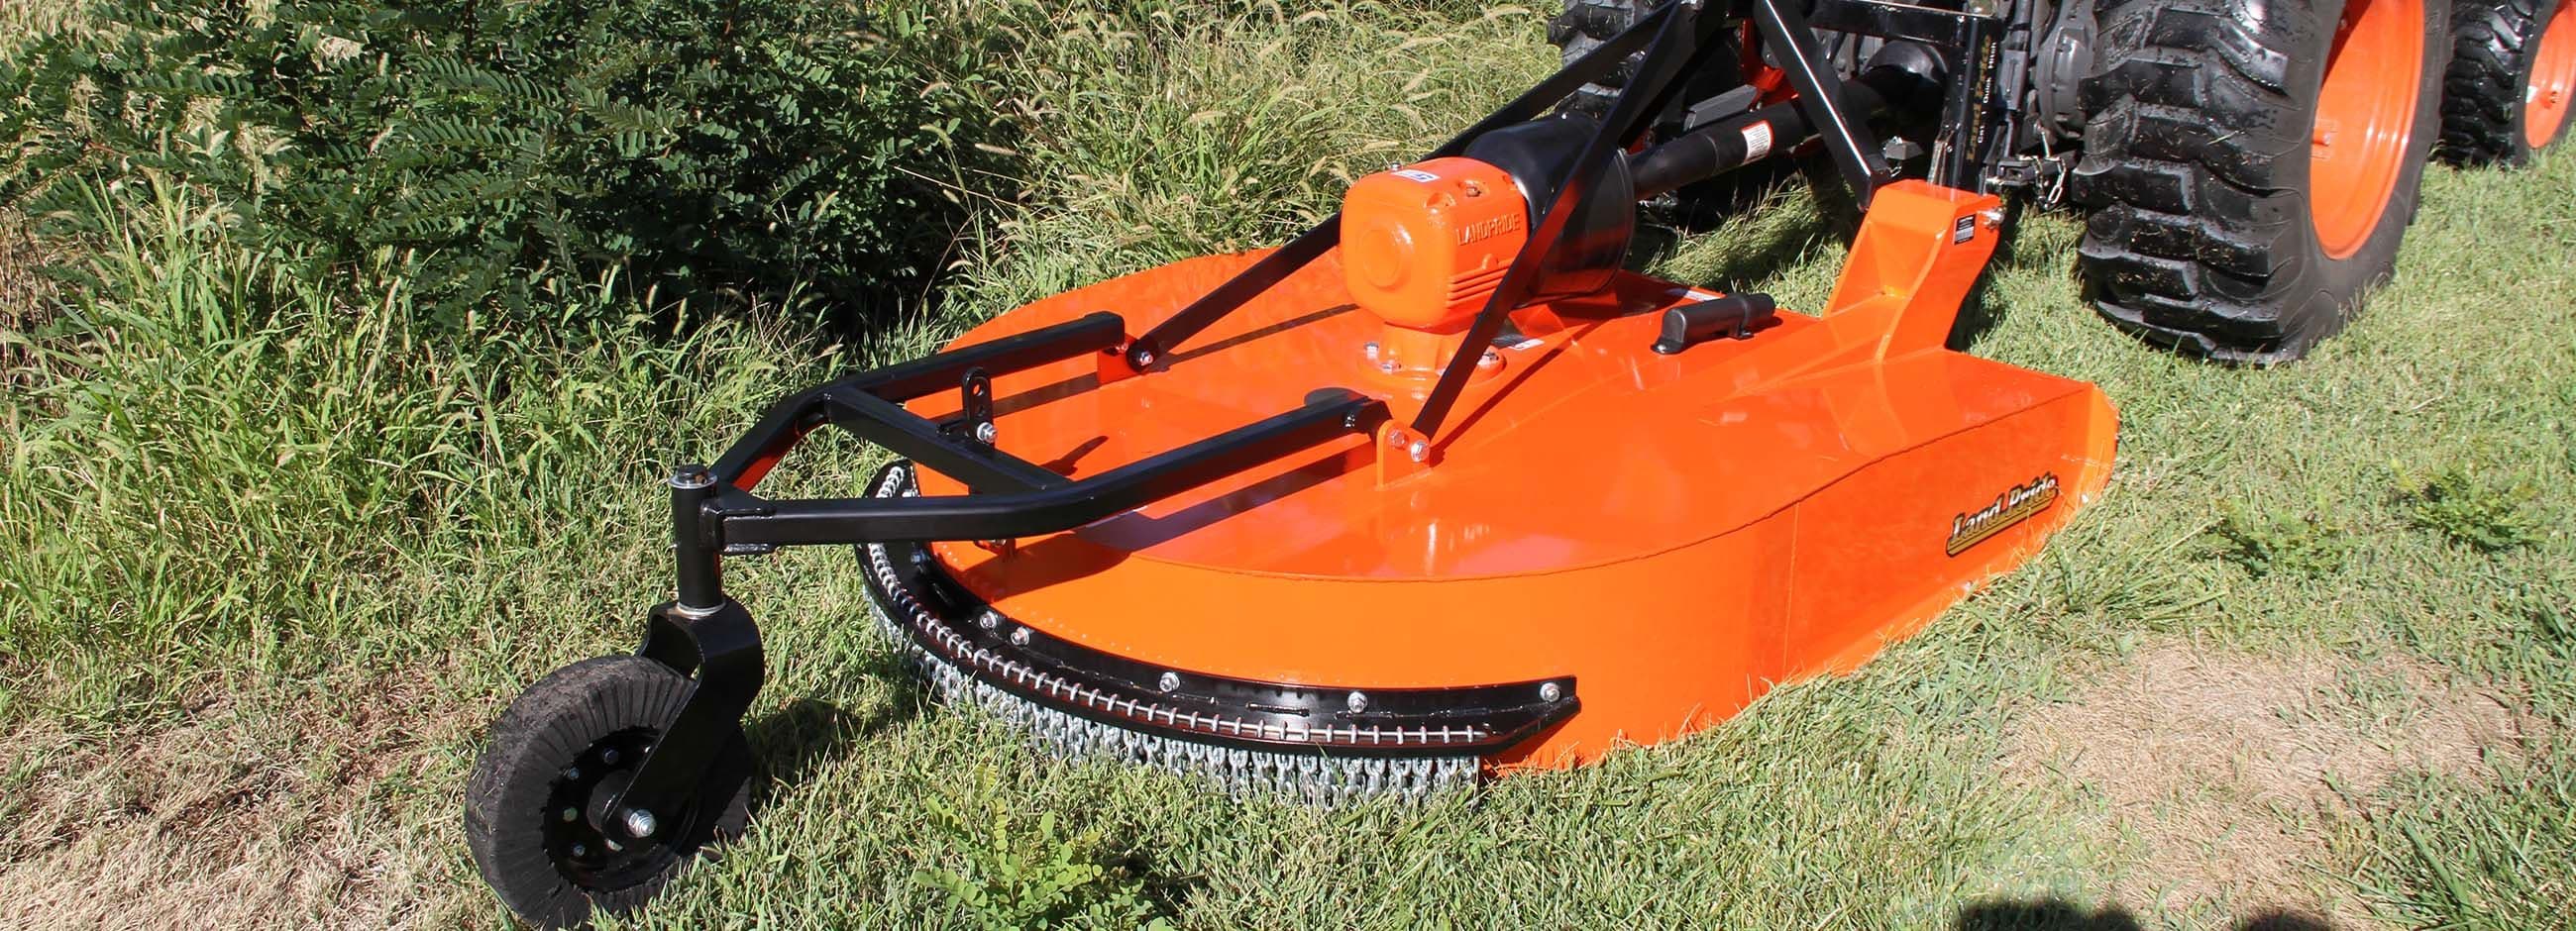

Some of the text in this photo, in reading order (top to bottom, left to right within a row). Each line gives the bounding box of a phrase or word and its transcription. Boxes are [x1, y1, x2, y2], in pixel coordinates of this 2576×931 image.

[1966, 34, 1992, 161] Land Pride
[1983, 76, 1991, 104] Quick
[1987, 42, 1997, 69] Hitch
[1952, 472, 2058, 538] Land Pride
